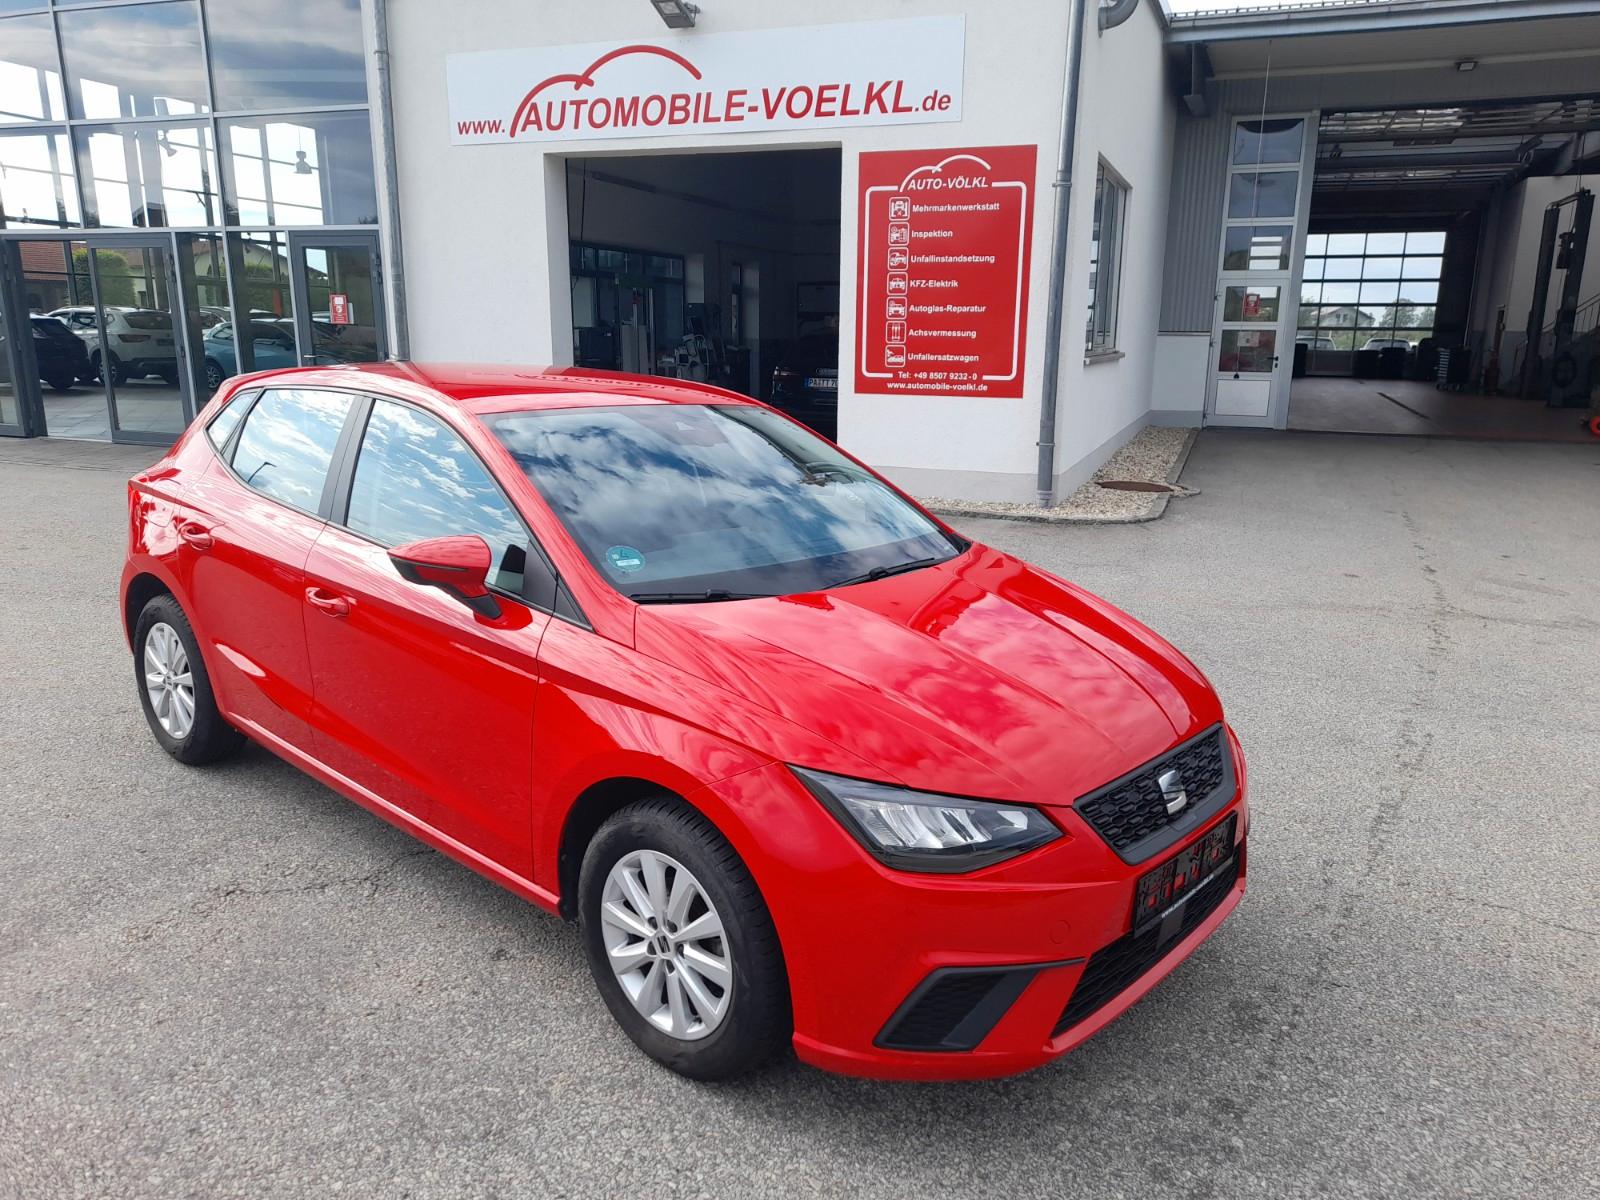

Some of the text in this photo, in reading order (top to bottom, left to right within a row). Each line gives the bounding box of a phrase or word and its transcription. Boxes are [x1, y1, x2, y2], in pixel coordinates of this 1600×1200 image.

[908, 176, 989, 191] AUTO-VÖLKL
[912, 202, 1000, 213] Mehrmarkenwerkstatt
[911, 229, 953, 239] Inspektion
[910, 254, 995, 264] Unfallinstandsetzung
[909, 279, 958, 288] KFZ-Elektrik
[909, 304, 986, 314] Autoglas-Reparatur
[908, 329, 977, 339] Achsvermessung
[907, 353, 979, 363] Unfallersatzwagen
[914, 371, 927, 380] +49
[929, 372, 947, 380] 8507
[887, 381, 988, 392] www.automobile-voelkl.de
